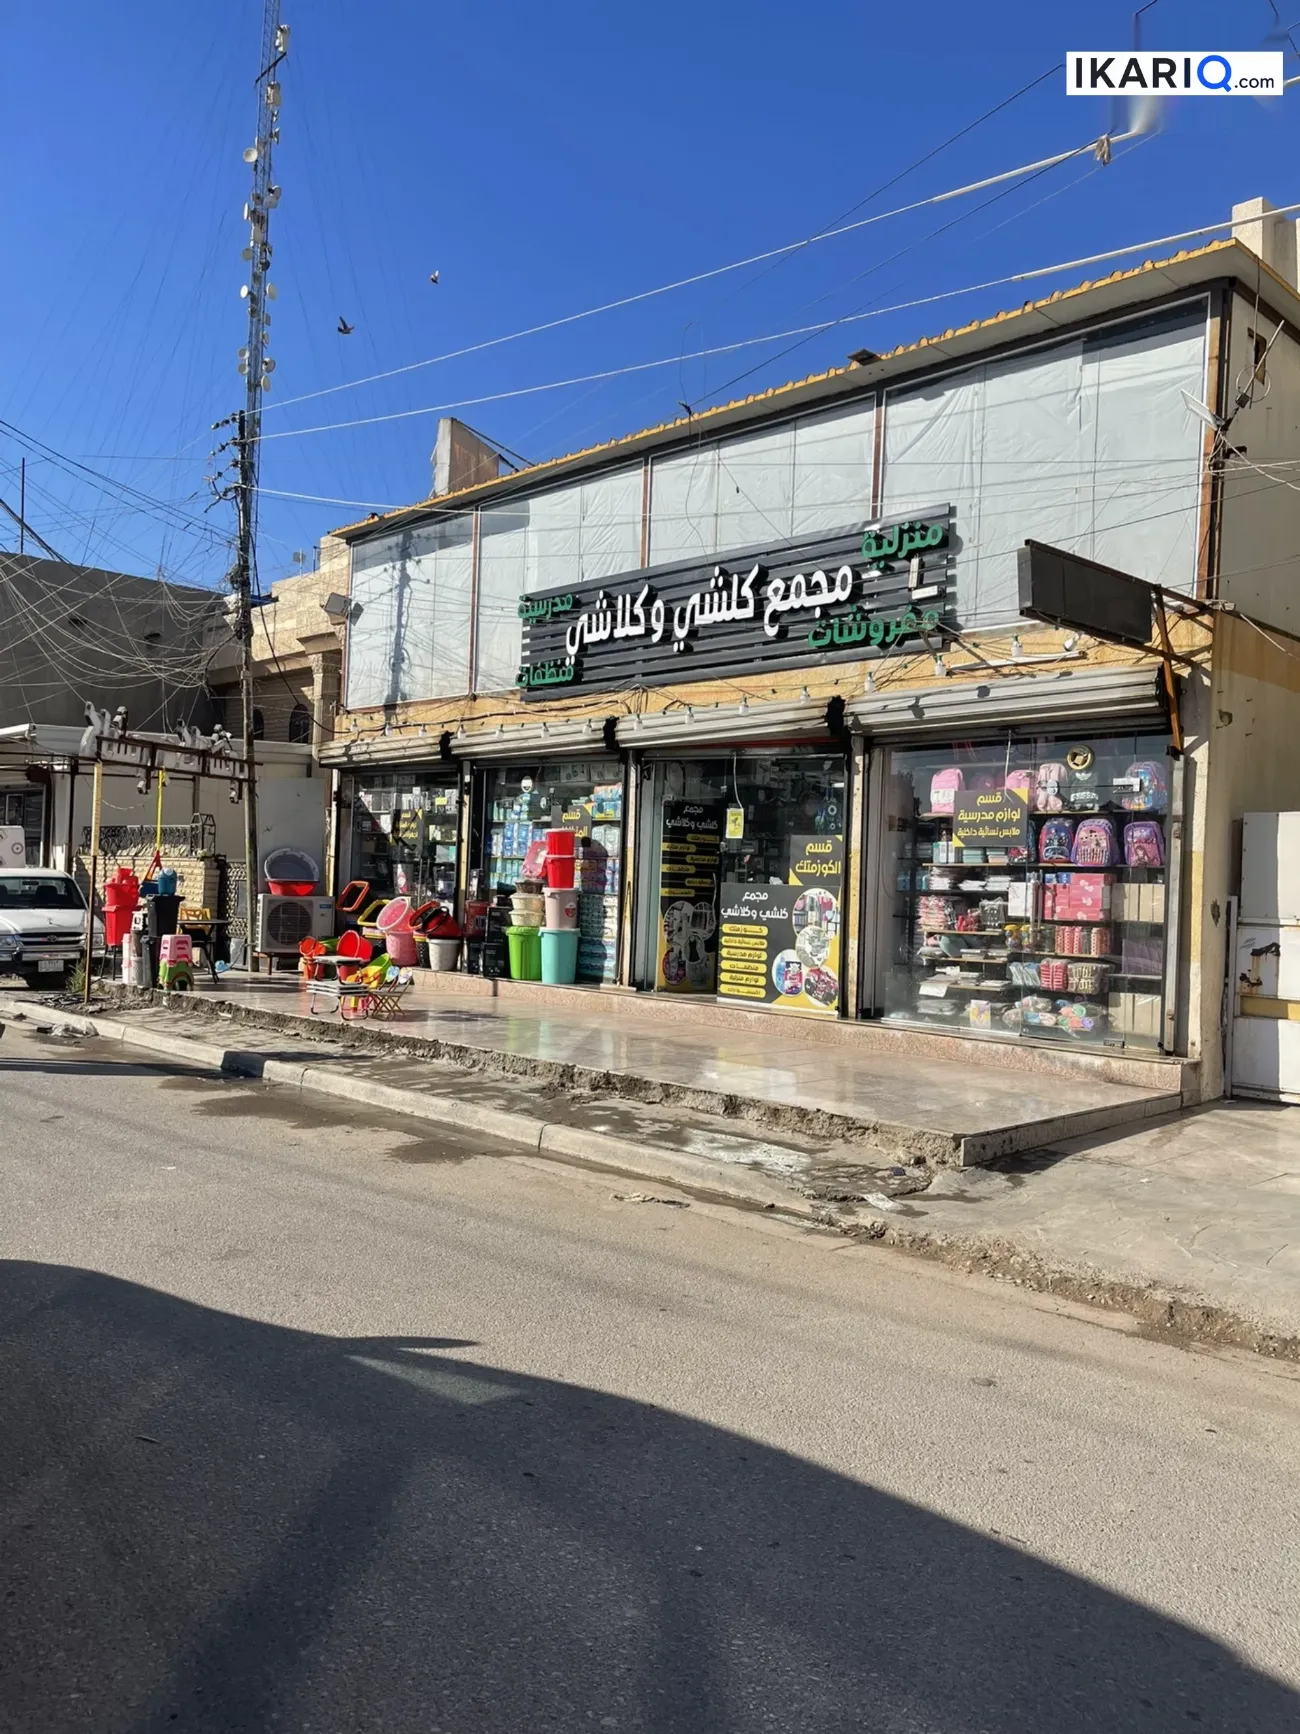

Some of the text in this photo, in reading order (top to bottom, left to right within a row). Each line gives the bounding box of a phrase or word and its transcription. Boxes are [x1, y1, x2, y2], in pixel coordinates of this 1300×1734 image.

[861, 521, 944, 570] منزلية
[673, 563, 760, 653] كلشي
[764, 565, 853, 637] مجمع
[517, 594, 573, 625] مدرسية
[808, 603, 940, 648] مفروشات
[515, 658, 575, 687] منظفات
[976, 792, 1002, 806] قسم
[562, 809, 581, 823] قسم
[683, 805, 704, 815] مجمع
[957, 808, 1021, 823] لوازم مدرسية
[696, 818, 719, 830] كلشي
[957, 827, 978, 838] داخلية
[998, 827, 1020, 838] ملابس
[805, 840, 833, 856] قسم
[795, 860, 842, 877] الكوزمتك
[742, 891, 769, 902] مجمع
[720, 904, 789, 921] كلشي وكلاشي
